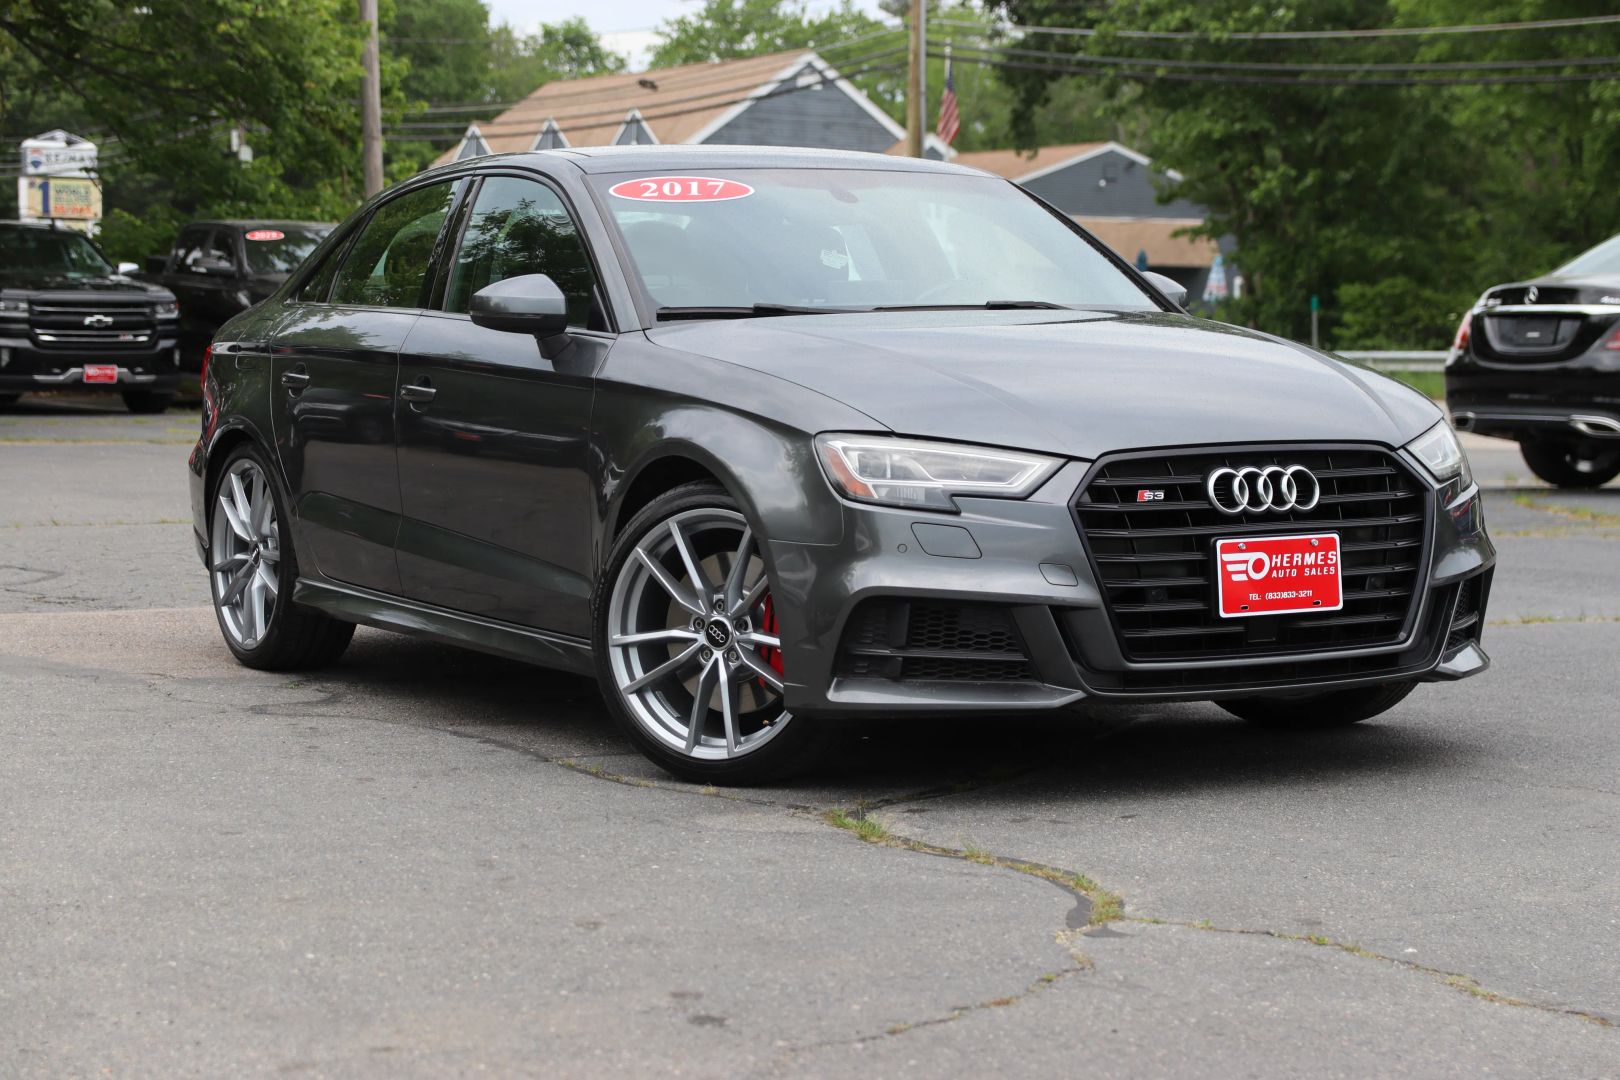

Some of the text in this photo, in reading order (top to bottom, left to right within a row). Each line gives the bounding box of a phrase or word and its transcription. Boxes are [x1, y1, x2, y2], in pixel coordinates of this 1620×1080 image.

[639, 181, 725, 197] 2017
[1142, 491, 1165, 500] S3
[1271, 551, 1337, 568] HERMES
[1271, 566, 1336, 578] AUTO SALES
[1248, 590, 1313, 601] TEL: (833)833-3211
